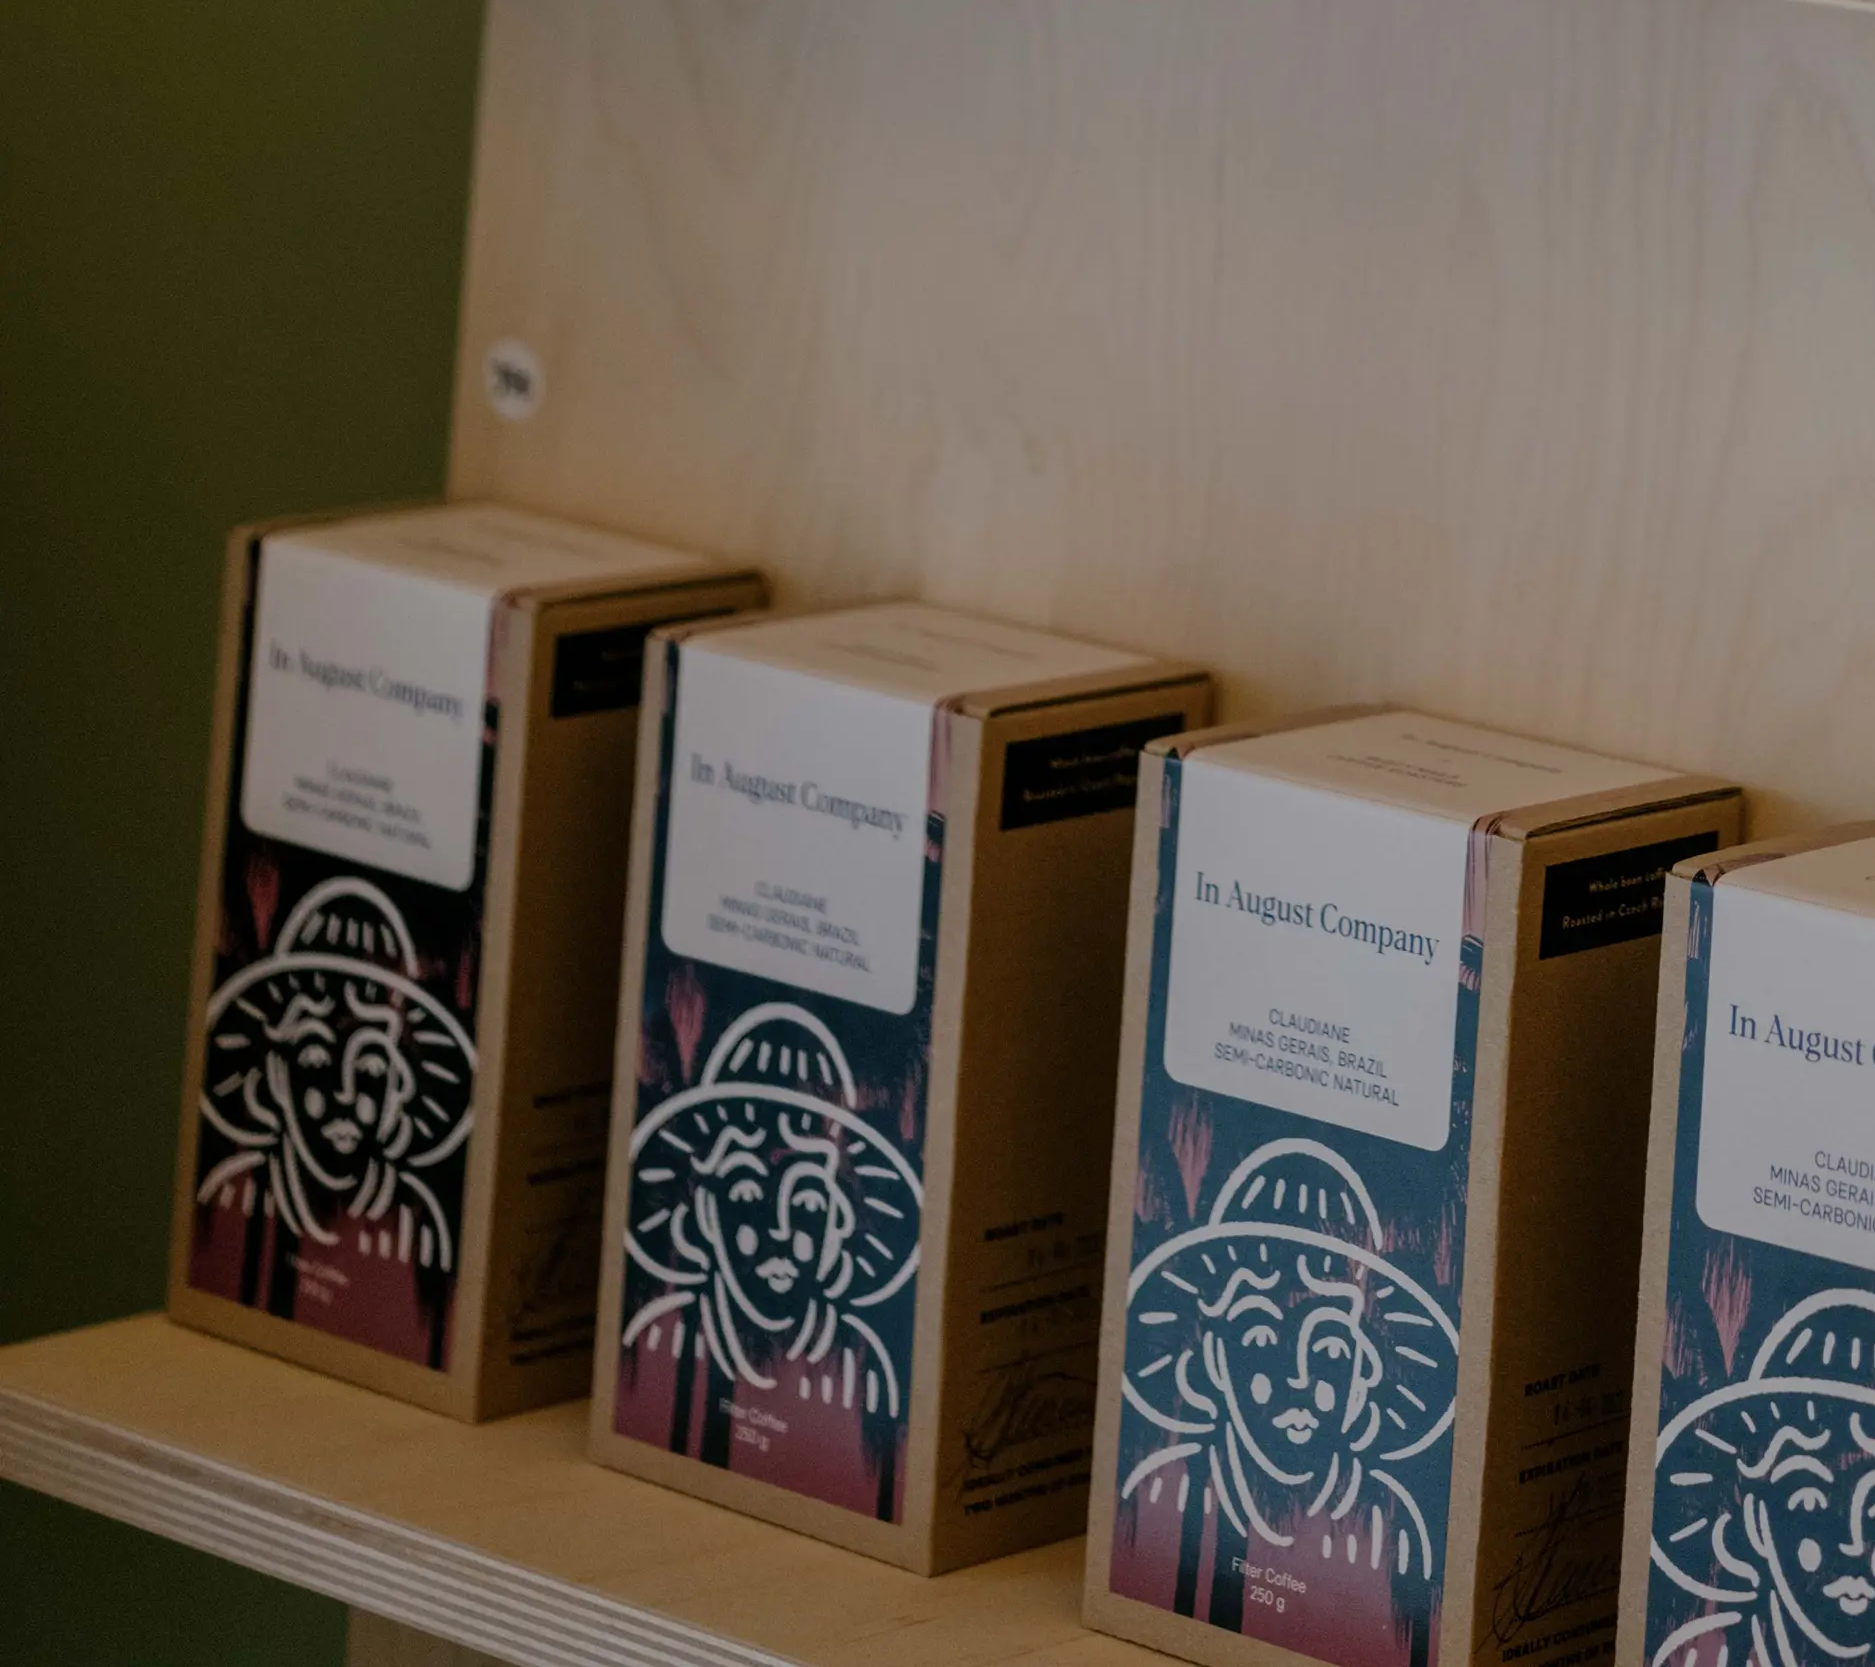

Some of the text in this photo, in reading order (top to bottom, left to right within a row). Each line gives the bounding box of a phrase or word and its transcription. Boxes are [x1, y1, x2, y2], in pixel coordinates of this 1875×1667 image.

[690, 751, 910, 841] In August Company
[1193, 870, 1441, 967] In August Company
[1228, 1021, 1388, 1079] MINAS GERAIS, BRAZIL
[1268, 1007, 1351, 1044] CLAUDIANE
[1728, 1003, 1758, 1042] In
[1764, 1013, 1866, 1066] August
[1213, 1041, 1400, 1107] SEMI-CARBONIC NATURAL
[1769, 1163, 1822, 1194] MINAS
[1231, 1555, 1308, 1595] Filter Coffee
[1249, 1584, 1286, 1614] 250 g
